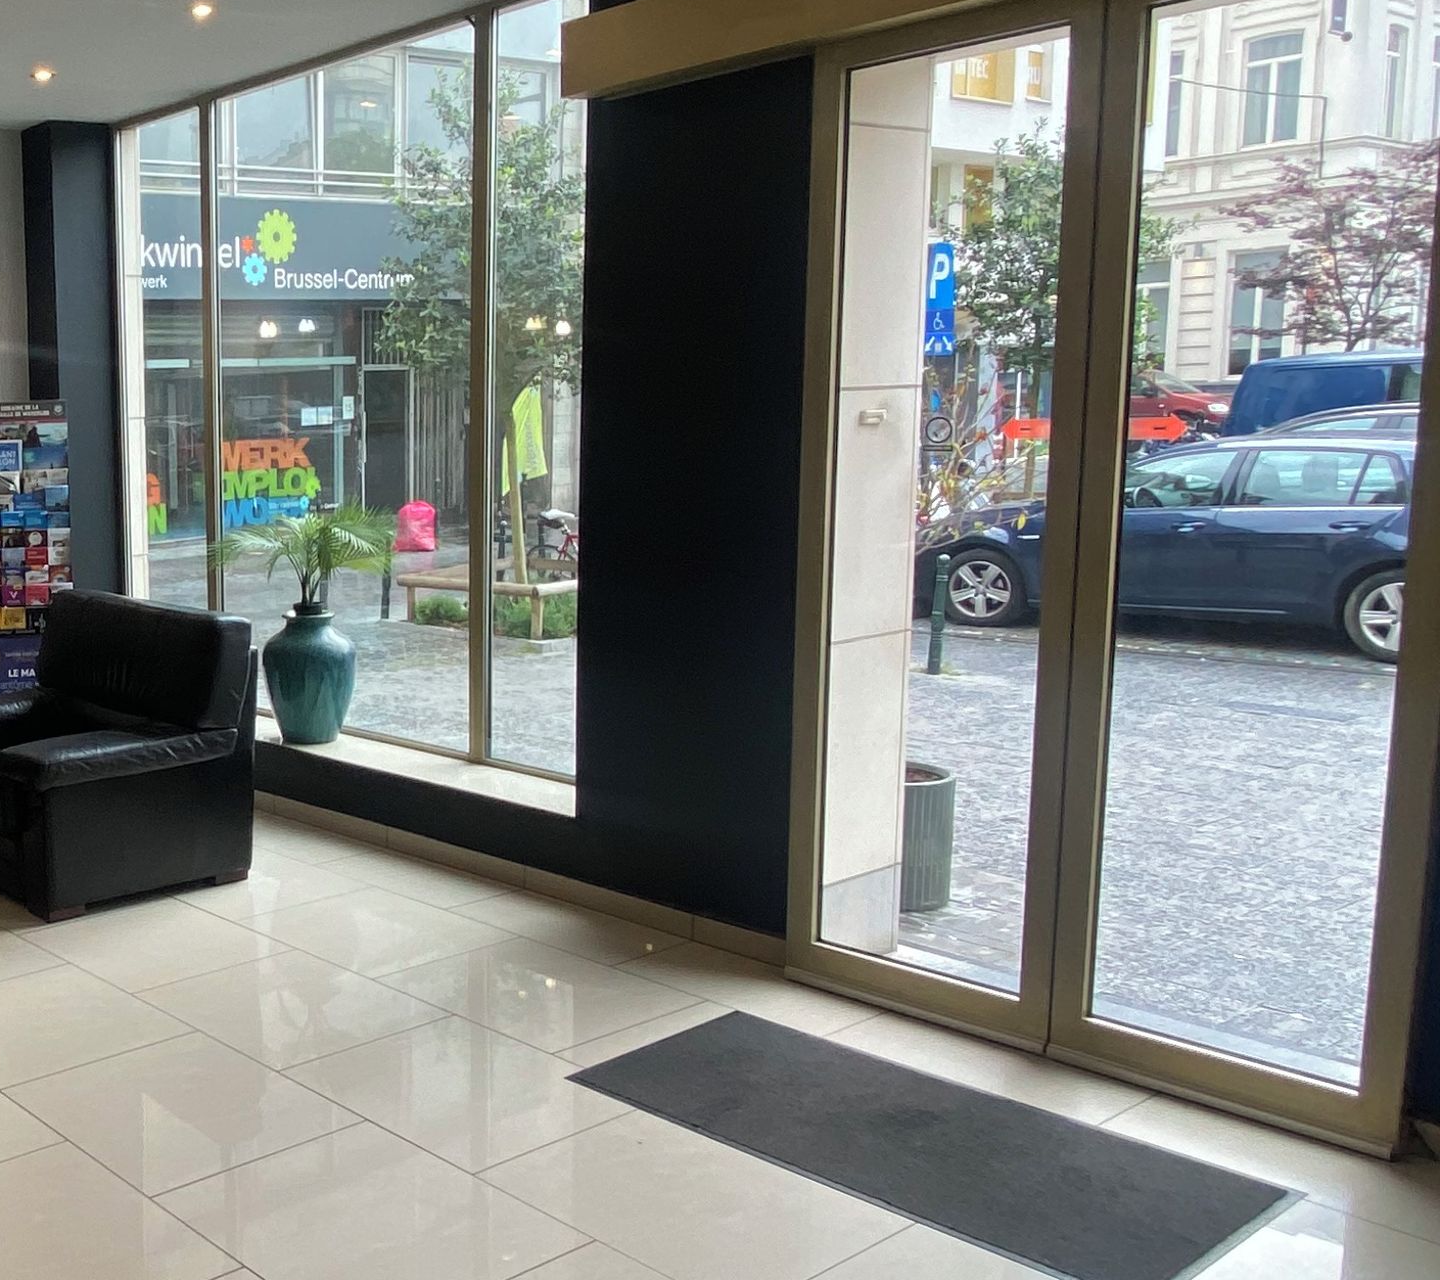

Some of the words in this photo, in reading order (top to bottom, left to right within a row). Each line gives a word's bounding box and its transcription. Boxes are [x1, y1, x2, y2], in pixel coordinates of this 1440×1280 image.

[140, 234, 241, 269] kwinel
[930, 253, 949, 299] P
[8, 668, 19, 678] LE
